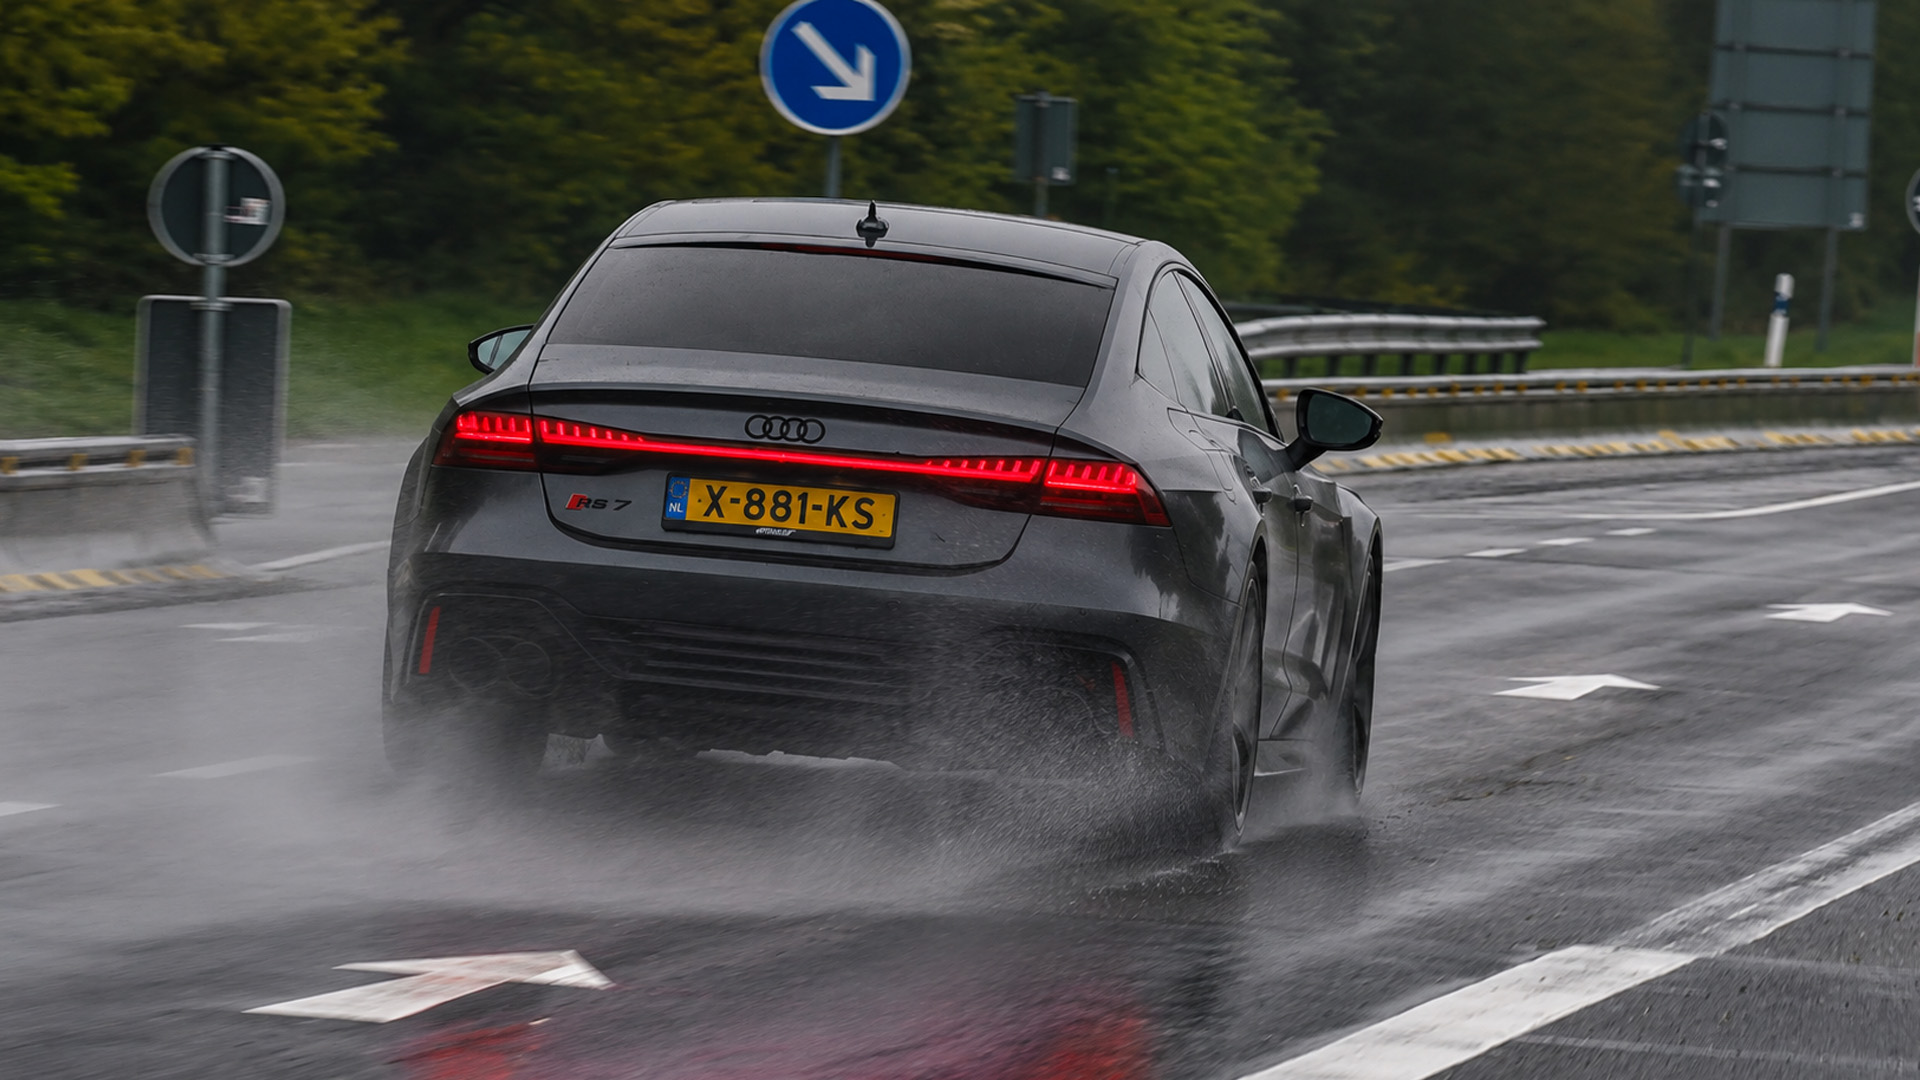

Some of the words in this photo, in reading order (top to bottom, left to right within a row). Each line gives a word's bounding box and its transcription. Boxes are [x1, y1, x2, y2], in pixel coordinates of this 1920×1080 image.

[569, 494, 608, 510] RS
[612, 499, 632, 511] 7
[668, 502, 684, 514] NL
[703, 485, 875, 529] X-881-KS
